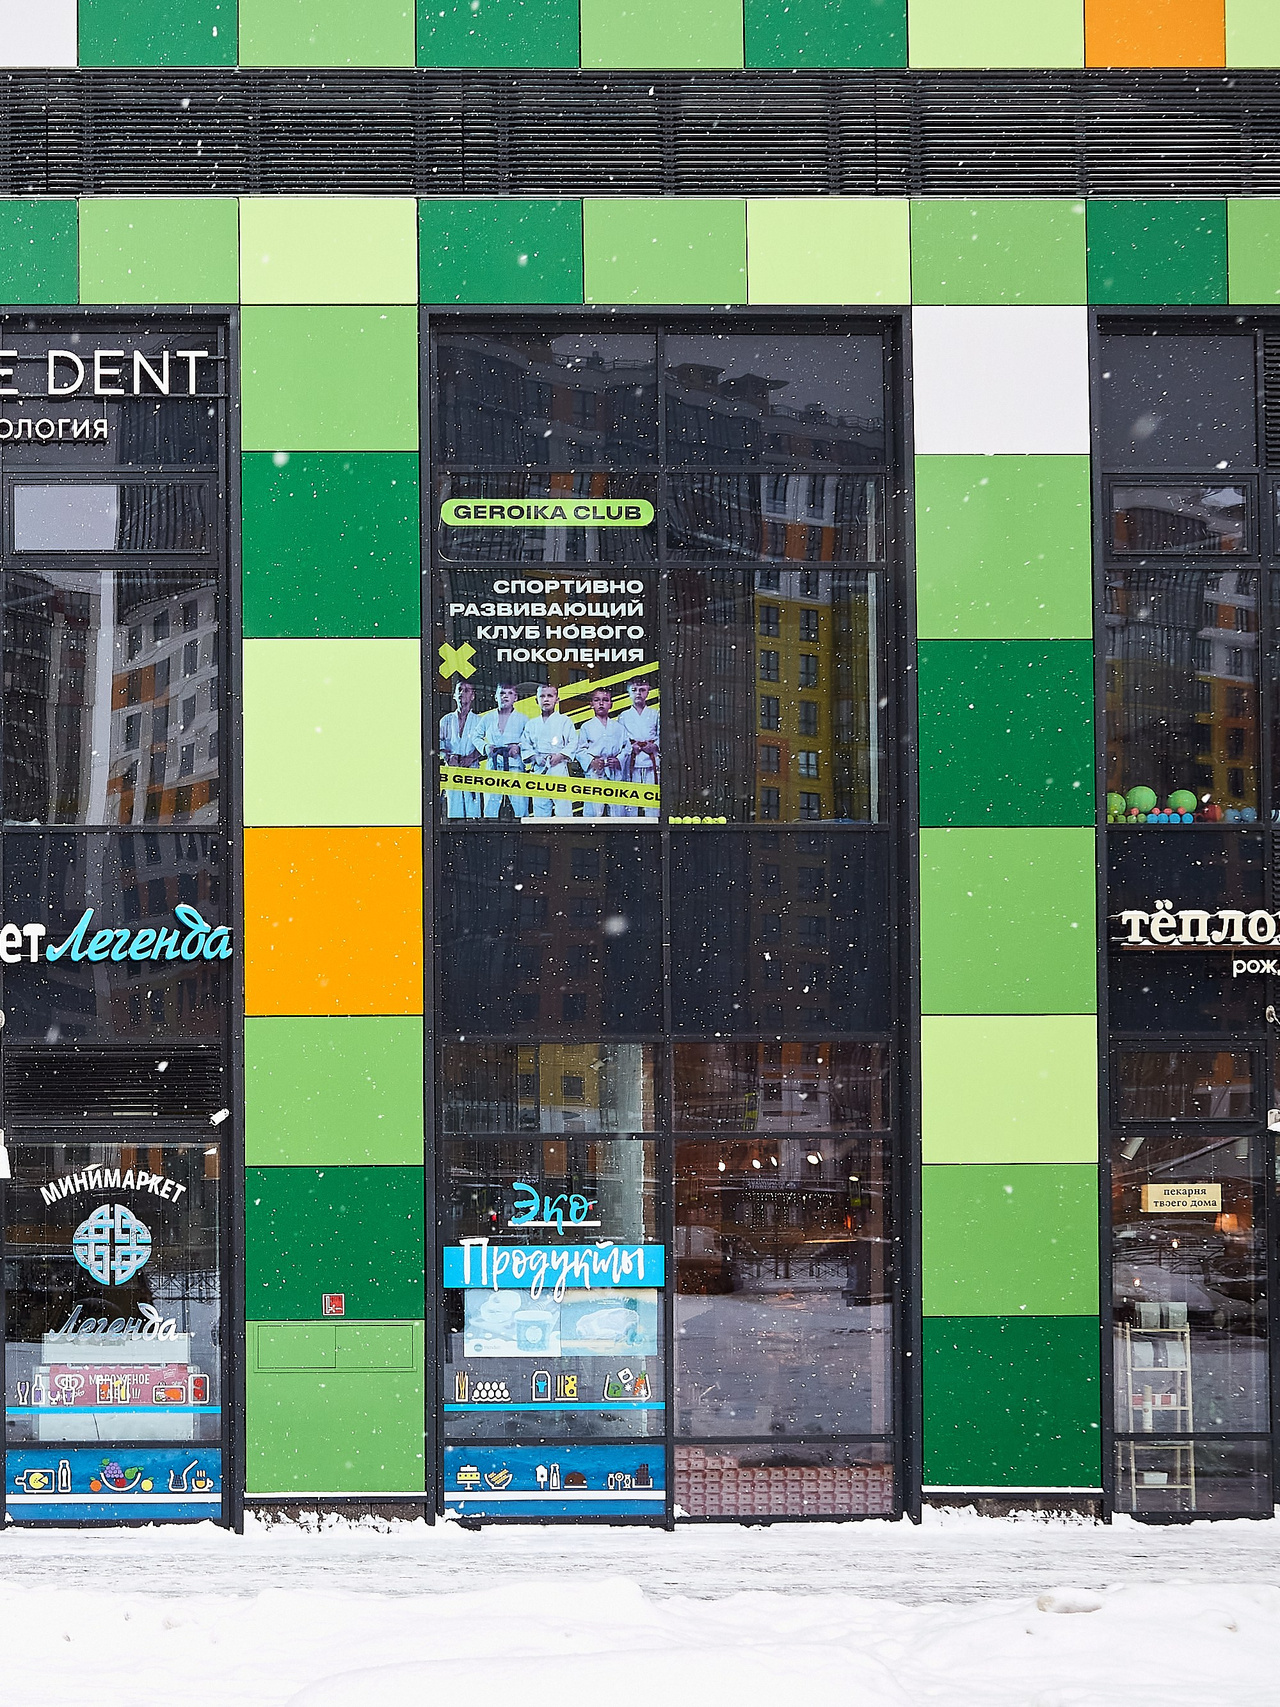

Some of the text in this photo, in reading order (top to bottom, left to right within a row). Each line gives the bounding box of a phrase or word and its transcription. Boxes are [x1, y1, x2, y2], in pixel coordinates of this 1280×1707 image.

[47, 349, 209, 396] DENT
[453, 504, 642, 520] GEROIKA CLUB
[493, 579, 644, 594] СПОРТИВНО
[449, 599, 644, 618] РАЗВИВАЮЩИЙ
[477, 624, 644, 640] КЛУБ НОВОГО
[497, 647, 644, 662] ПОКОЛЕНИЯ
[452, 774, 522, 789] GEROIKA
[525, 780, 567, 793] CLUB
[571, 785, 639, 799] GEROIKA
[1121, 899, 1280, 943] тёпло
[45, 902, 235, 963] Легенда
[1232, 959, 1280, 978] рож
[39, 1168, 187, 1206] МИНИМАРКЕТ
[1163, 1187, 1207, 1198] пекарня
[511, 1181, 599, 1236] Эко
[1153, 1199, 1218, 1208] твоего дома
[458, 1236, 645, 1304] Продукты
[49, 1302, 179, 1343] Легенда
